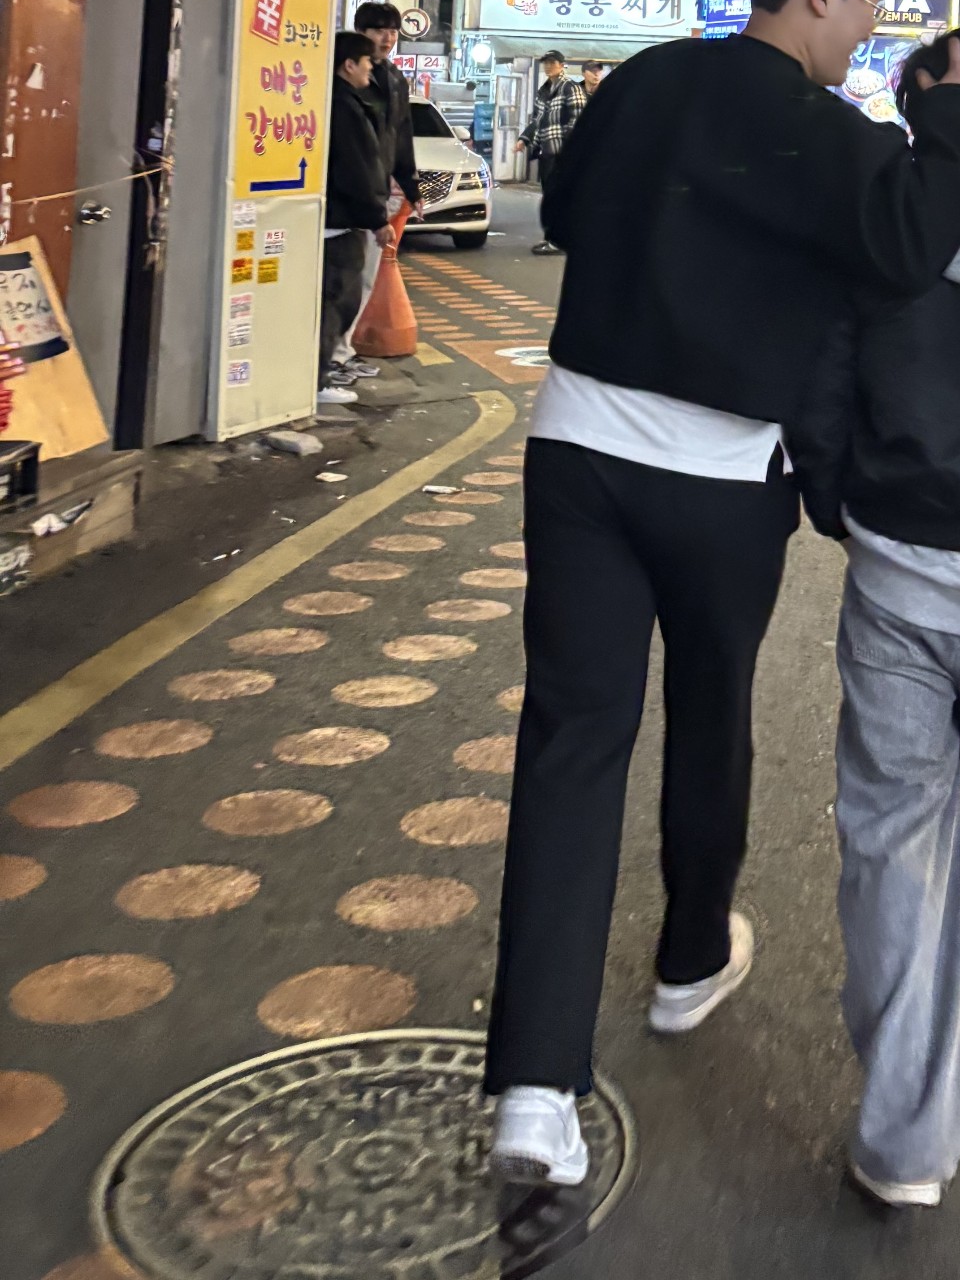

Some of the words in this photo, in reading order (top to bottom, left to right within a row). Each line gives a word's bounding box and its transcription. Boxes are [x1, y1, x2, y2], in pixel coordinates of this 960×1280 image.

[902, 12, 922, 22] PUB
[424, 57, 440, 68] 24
[260, 60, 308, 104] 매운
[245, 105, 317, 156] 갈비찜
